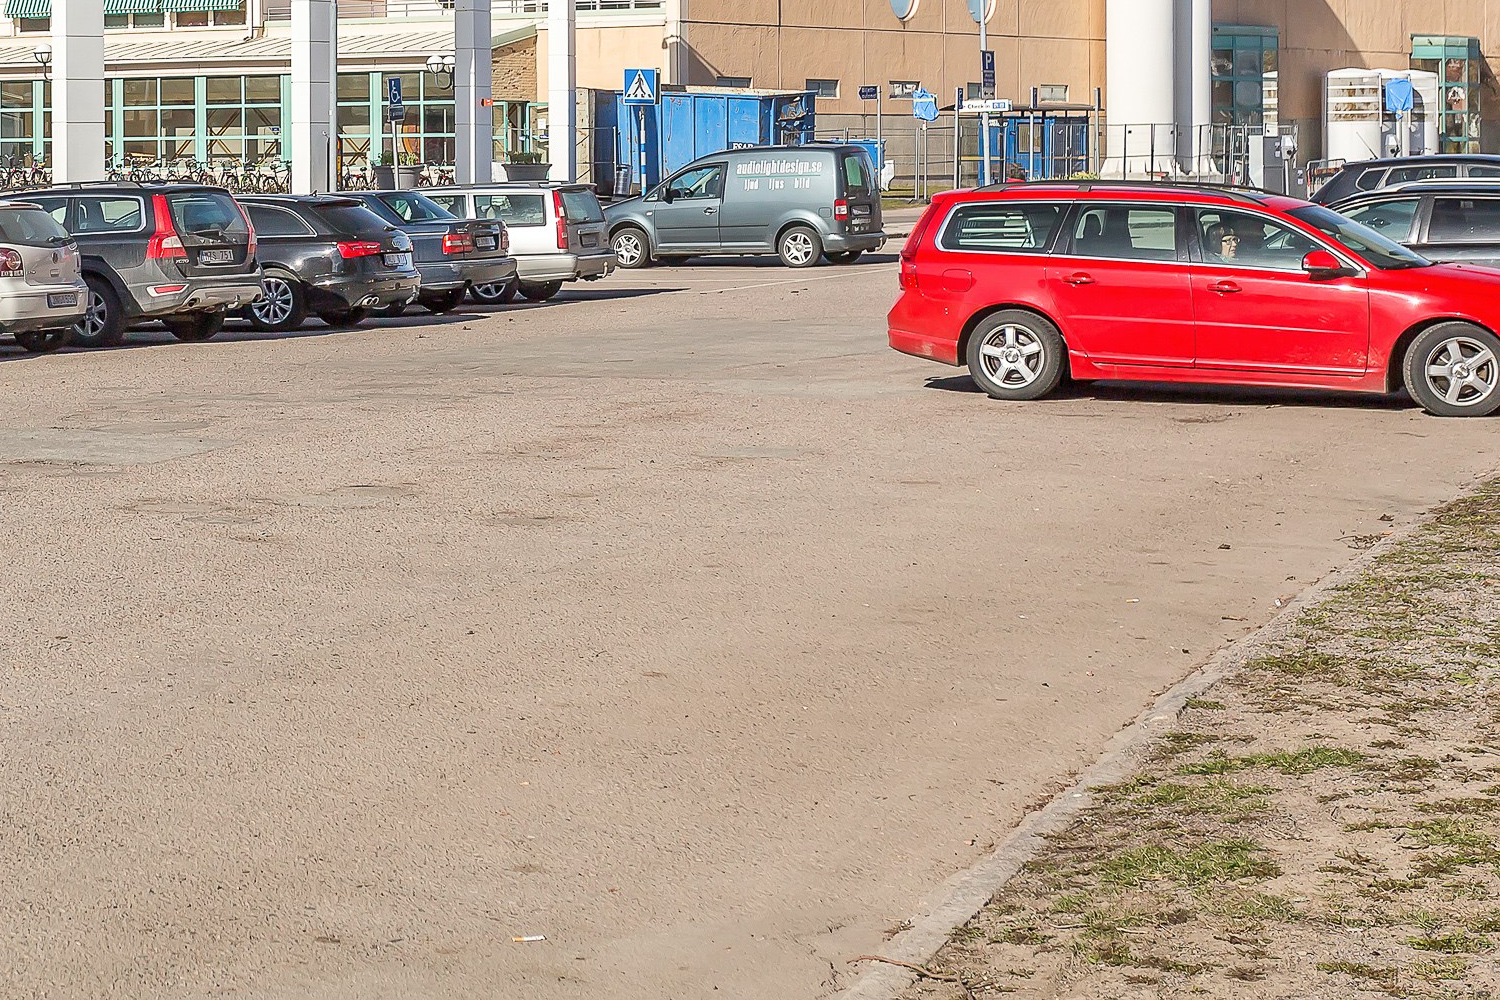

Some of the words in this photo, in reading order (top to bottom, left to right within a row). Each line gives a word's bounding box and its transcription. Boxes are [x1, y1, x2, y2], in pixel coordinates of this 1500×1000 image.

[985, 52, 992, 70] P
[736, 160, 822, 176] audiolightdesign.se
[744, 179, 759, 191] ljud
[768, 178, 785, 191] ljus
[794, 178, 810, 189] bild
